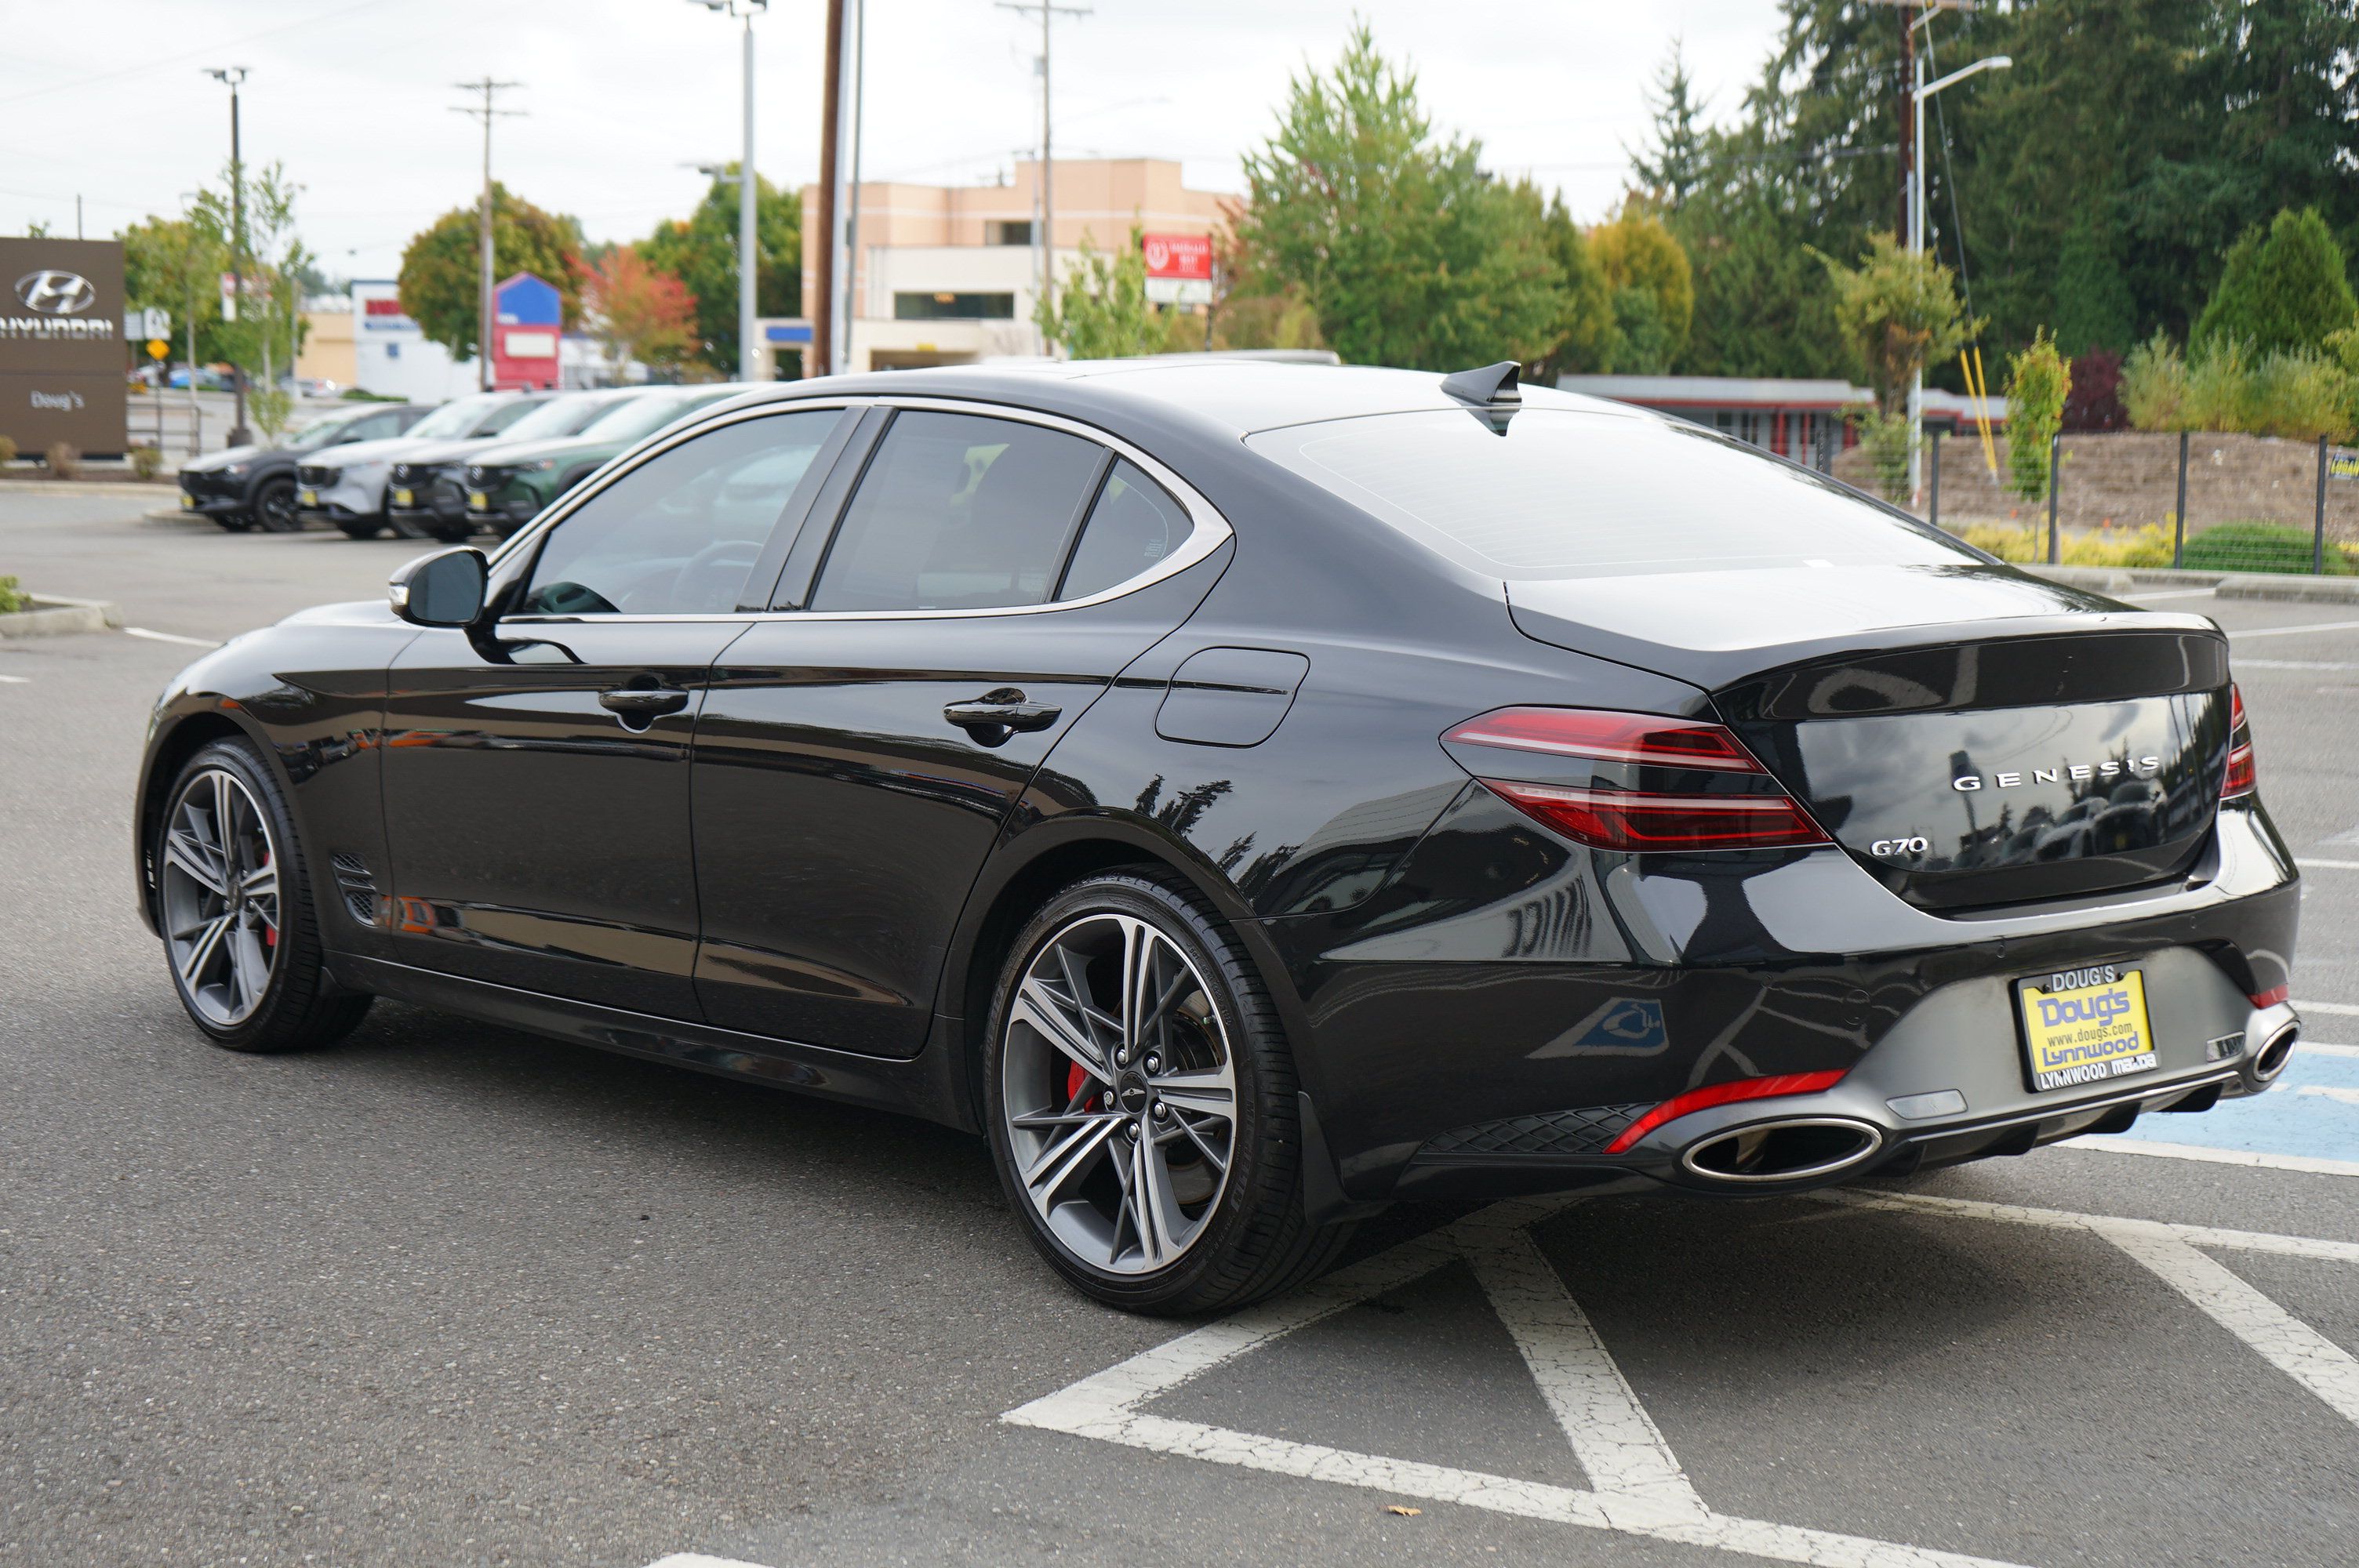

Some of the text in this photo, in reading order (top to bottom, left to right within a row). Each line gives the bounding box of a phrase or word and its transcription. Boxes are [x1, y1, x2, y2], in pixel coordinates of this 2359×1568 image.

[0, 318, 113, 339] HYUNDAI
[1953, 756, 2160, 792] GENESIS
[1870, 836, 1928, 858] G70
[2051, 964, 2117, 993] DOUG'S
[2047, 1022, 2133, 1047] www.dougs.com
[2041, 1031, 2139, 1067] Lynnwood
[2040, 1062, 2108, 1090] LYNNWOOD
